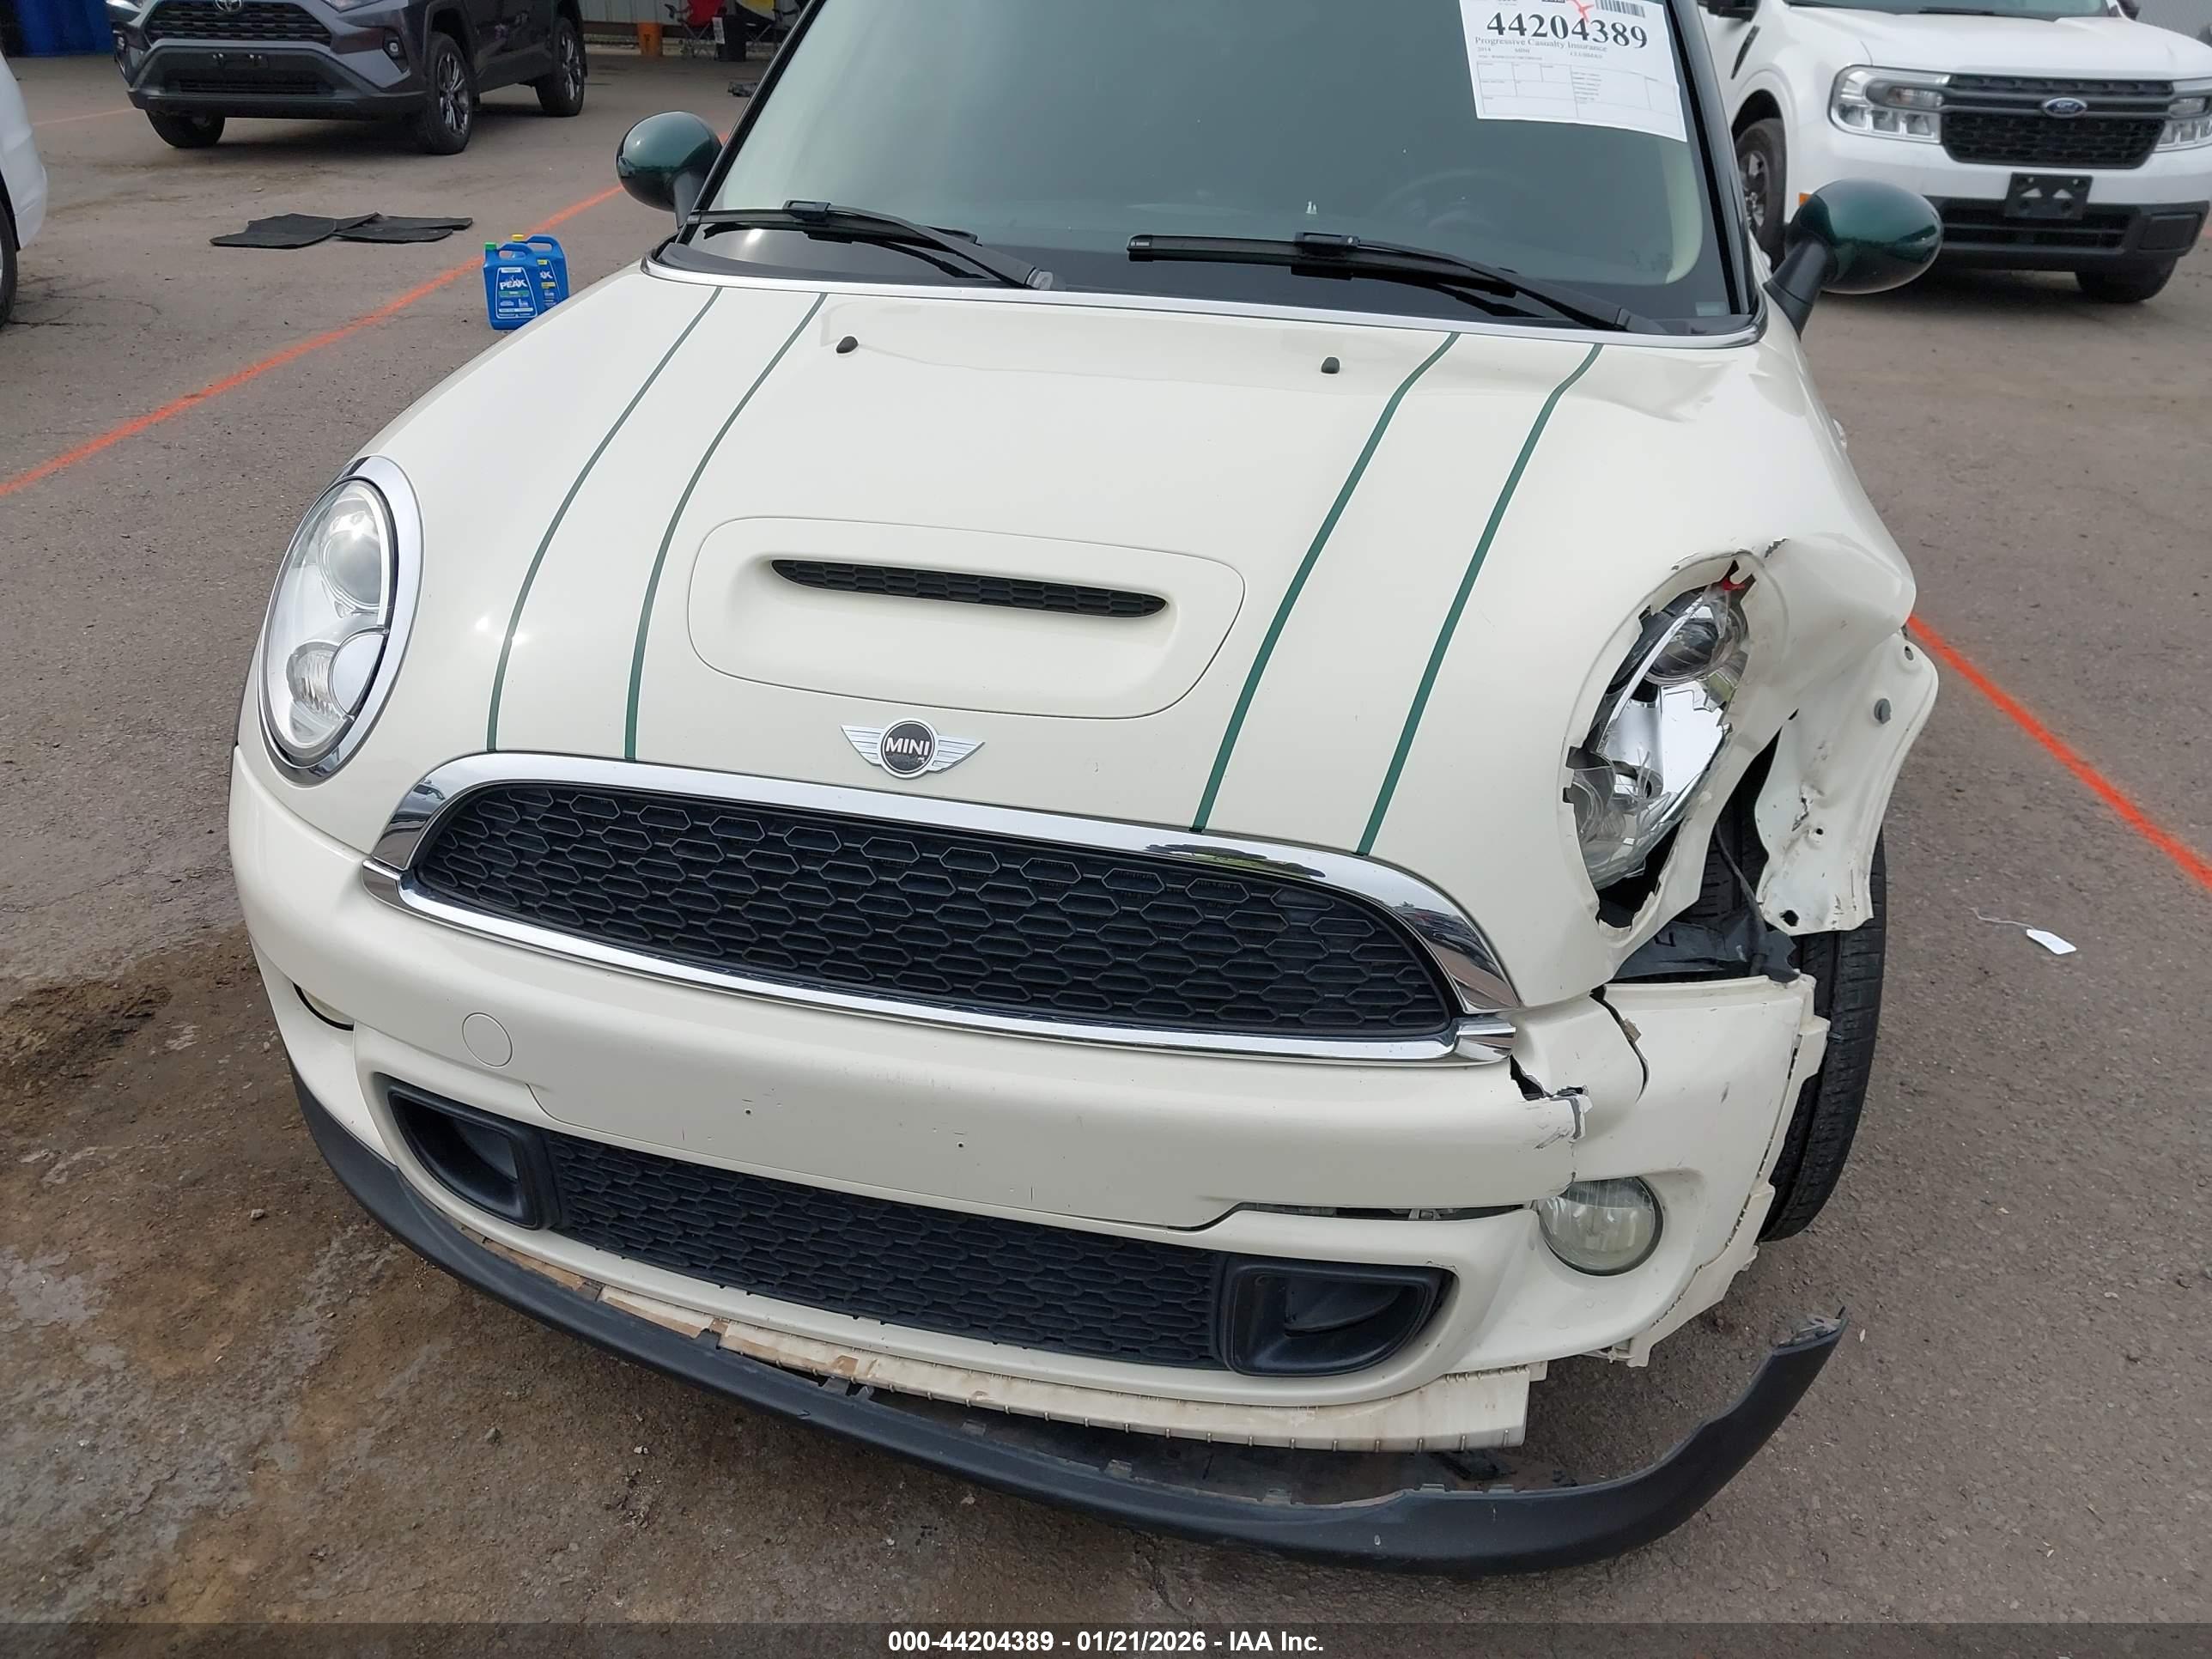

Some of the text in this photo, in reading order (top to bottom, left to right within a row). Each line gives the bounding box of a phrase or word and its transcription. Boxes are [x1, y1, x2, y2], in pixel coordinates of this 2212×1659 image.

[1486, 11, 1648, 49] 44204389
[1475, 36, 1608, 52] Progressive Casualty Insurance
[499, 279, 527, 290] PEAK
[885, 737, 930, 756] MINI
